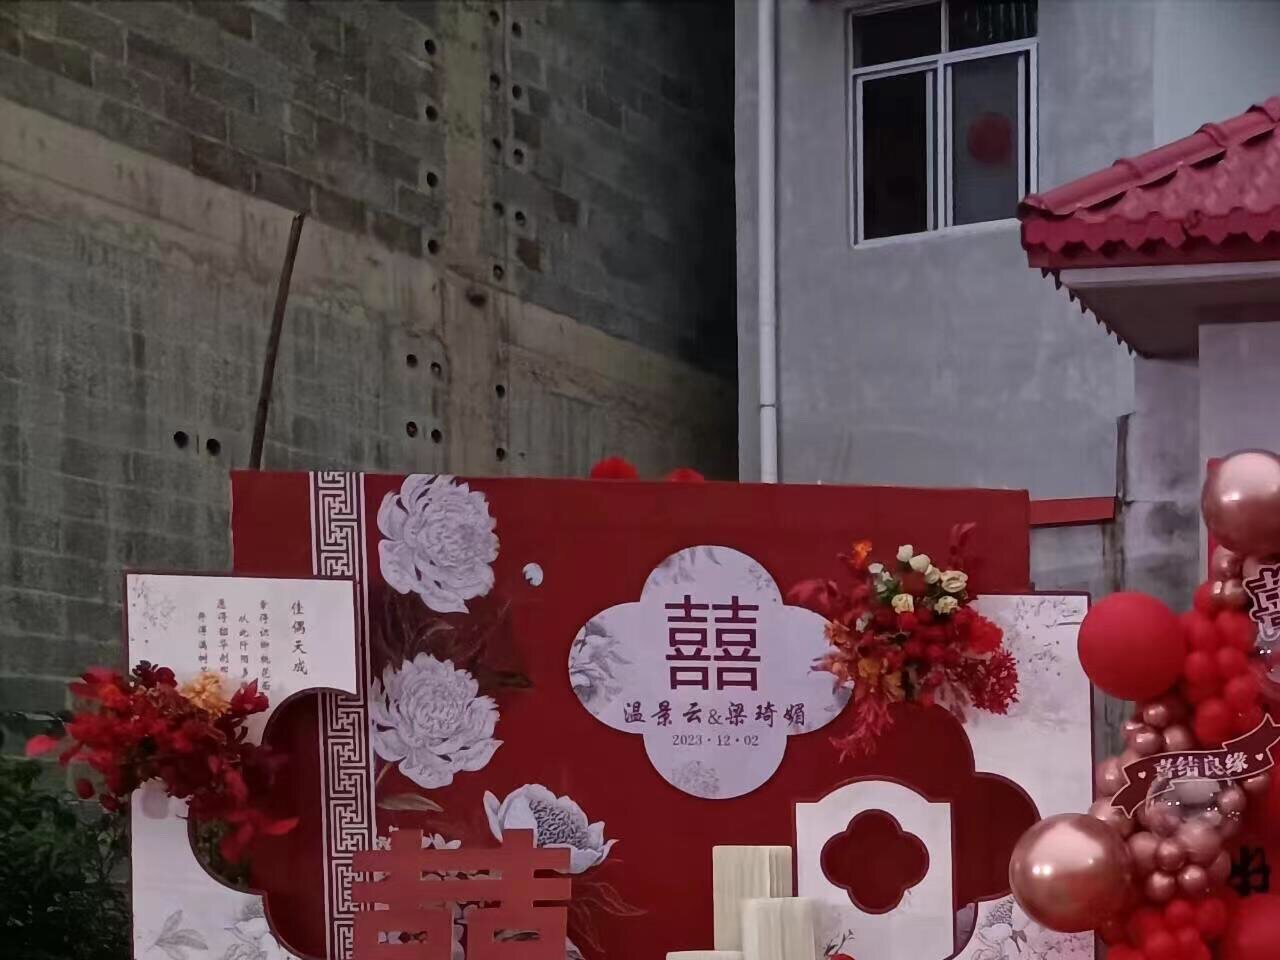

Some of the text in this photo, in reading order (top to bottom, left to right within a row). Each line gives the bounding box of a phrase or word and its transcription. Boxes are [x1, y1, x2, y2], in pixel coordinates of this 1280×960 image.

[291, 599, 309, 675] 佳偶天成
[664, 594, 761, 691] 囍
[1153, 754, 1249, 780] 喜结良缘
